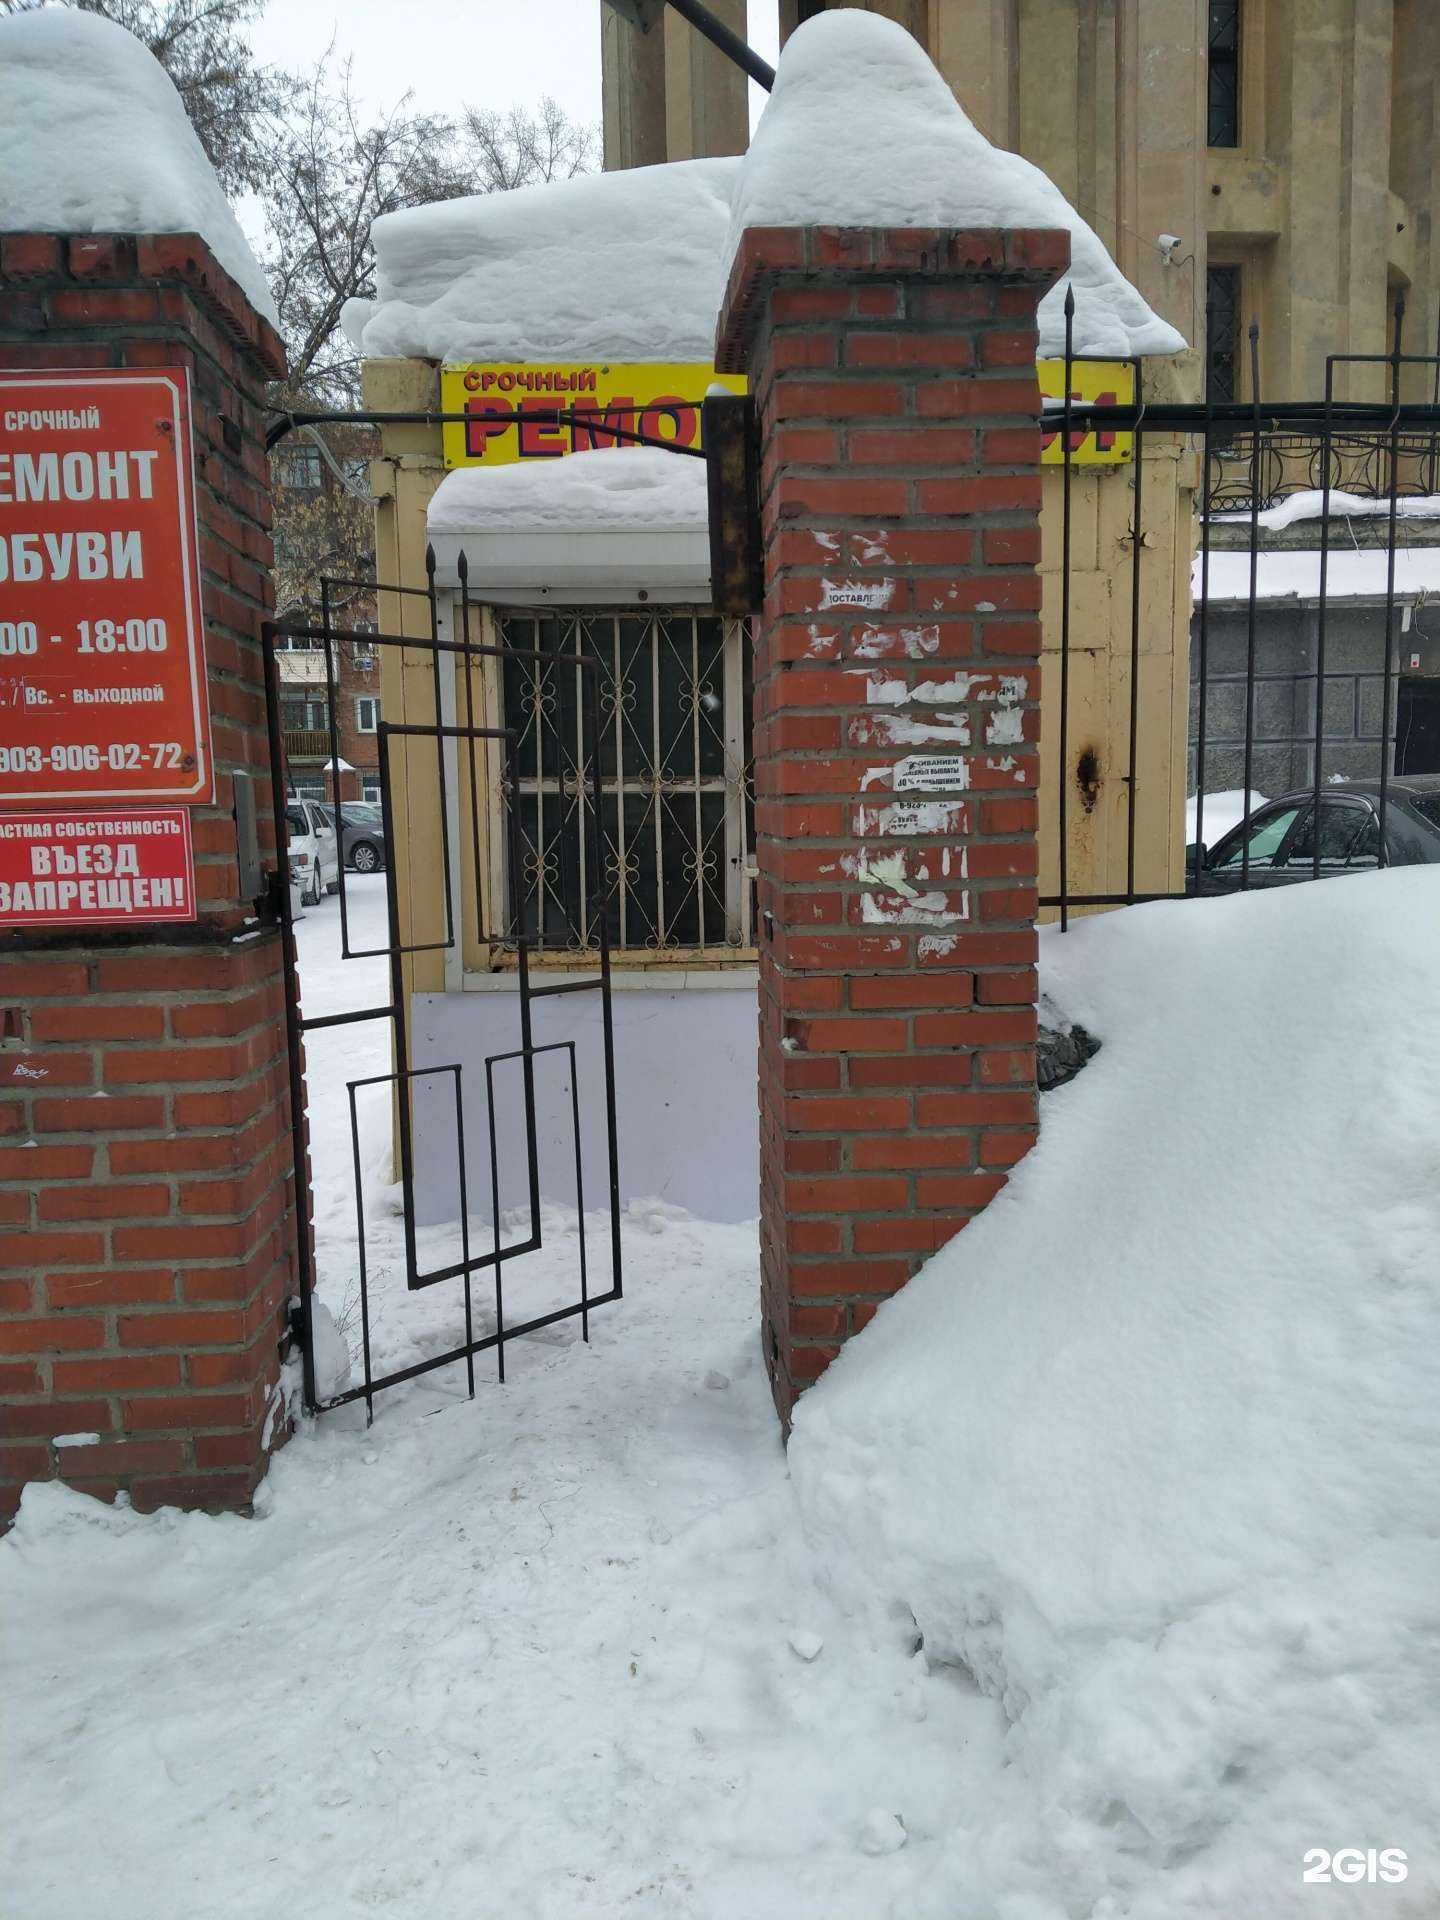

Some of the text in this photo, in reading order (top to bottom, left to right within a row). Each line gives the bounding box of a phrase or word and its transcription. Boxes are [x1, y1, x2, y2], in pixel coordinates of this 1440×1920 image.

[464, 367, 597, 392] СРОЧНЫЙ
[4, 405, 100, 431] СРОЧНЫЙ
[0, 530, 144, 582] БУВИ
[77, 618, 168, 653] 18:00
[25, 686, 54, 705] Вс.
[72, 684, 164, 705] выходной
[55, 820, 181, 838] СОБСТВЕННОСТЬ
[30, 843, 140, 877] ВЪЕЗД
[0, 877, 185, 913] ЗАПРЕЩЕН!
